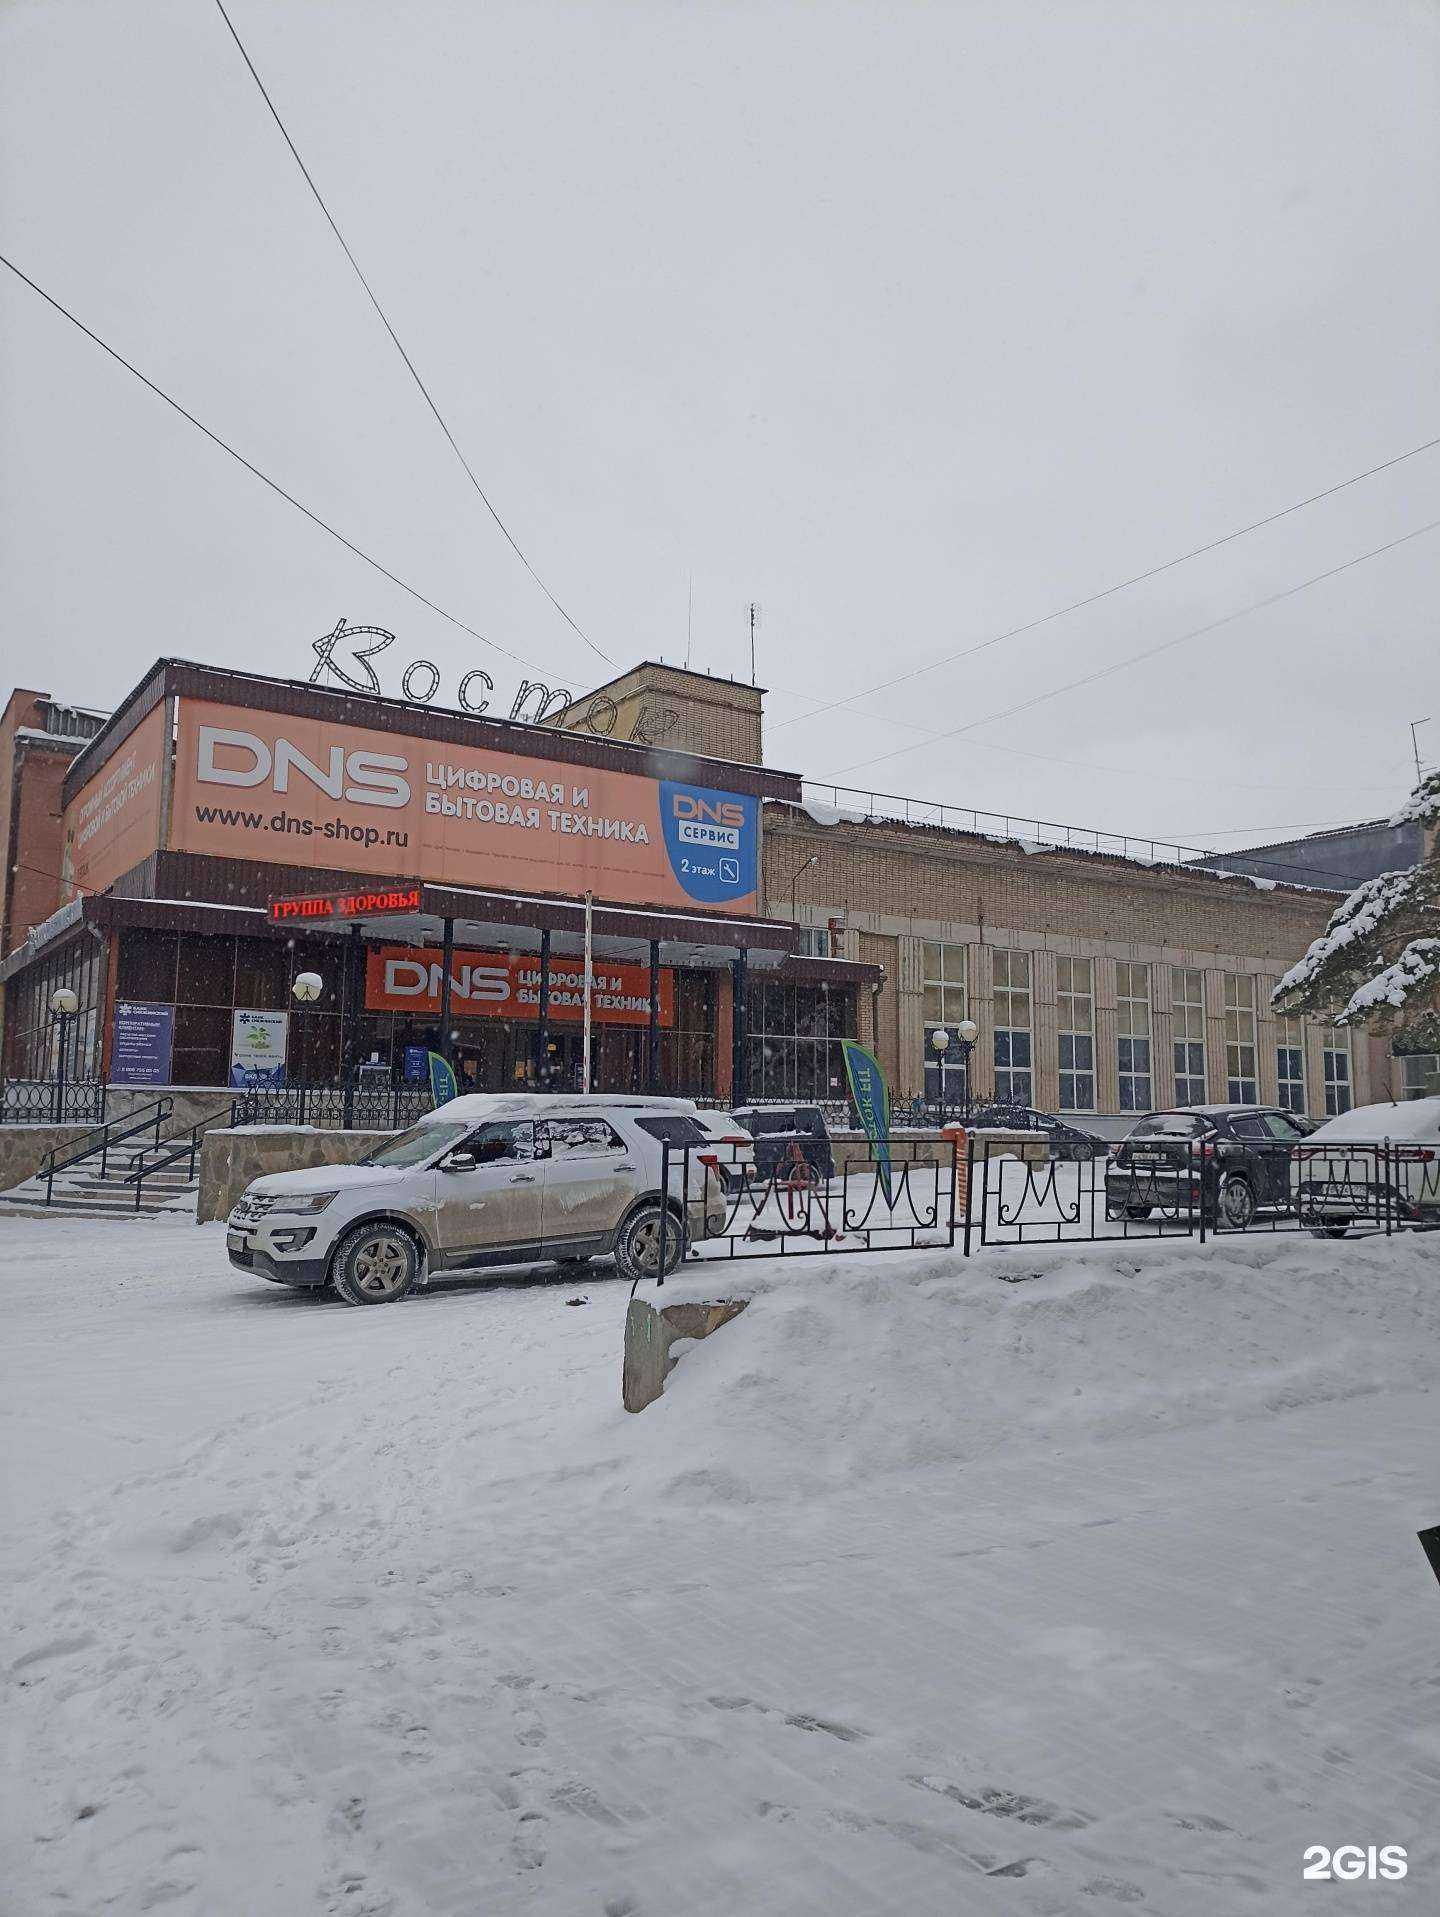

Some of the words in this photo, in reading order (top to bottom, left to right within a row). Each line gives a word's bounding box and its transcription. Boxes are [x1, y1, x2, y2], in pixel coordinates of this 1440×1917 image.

[197, 725, 412, 809] DNS
[426, 763, 565, 804] ЦИФРОВАЯ
[572, 787, 589, 808] И
[195, 805, 409, 848] www.dns-shop.ru
[425, 792, 541, 829] БЫТОВАЯ
[548, 810, 650, 844] ТЕХНИКА
[673, 794, 745, 827] DNS
[684, 826, 734, 843] СЕРВИС
[681, 858, 690, 873] 2
[691, 866, 716, 876] этаж
[273, 898, 334, 921] ГРУППА
[337, 889, 420, 915] ЗДОРОВЬЯ
[385, 960, 511, 1001] DNS
[609, 977, 622, 991] И
